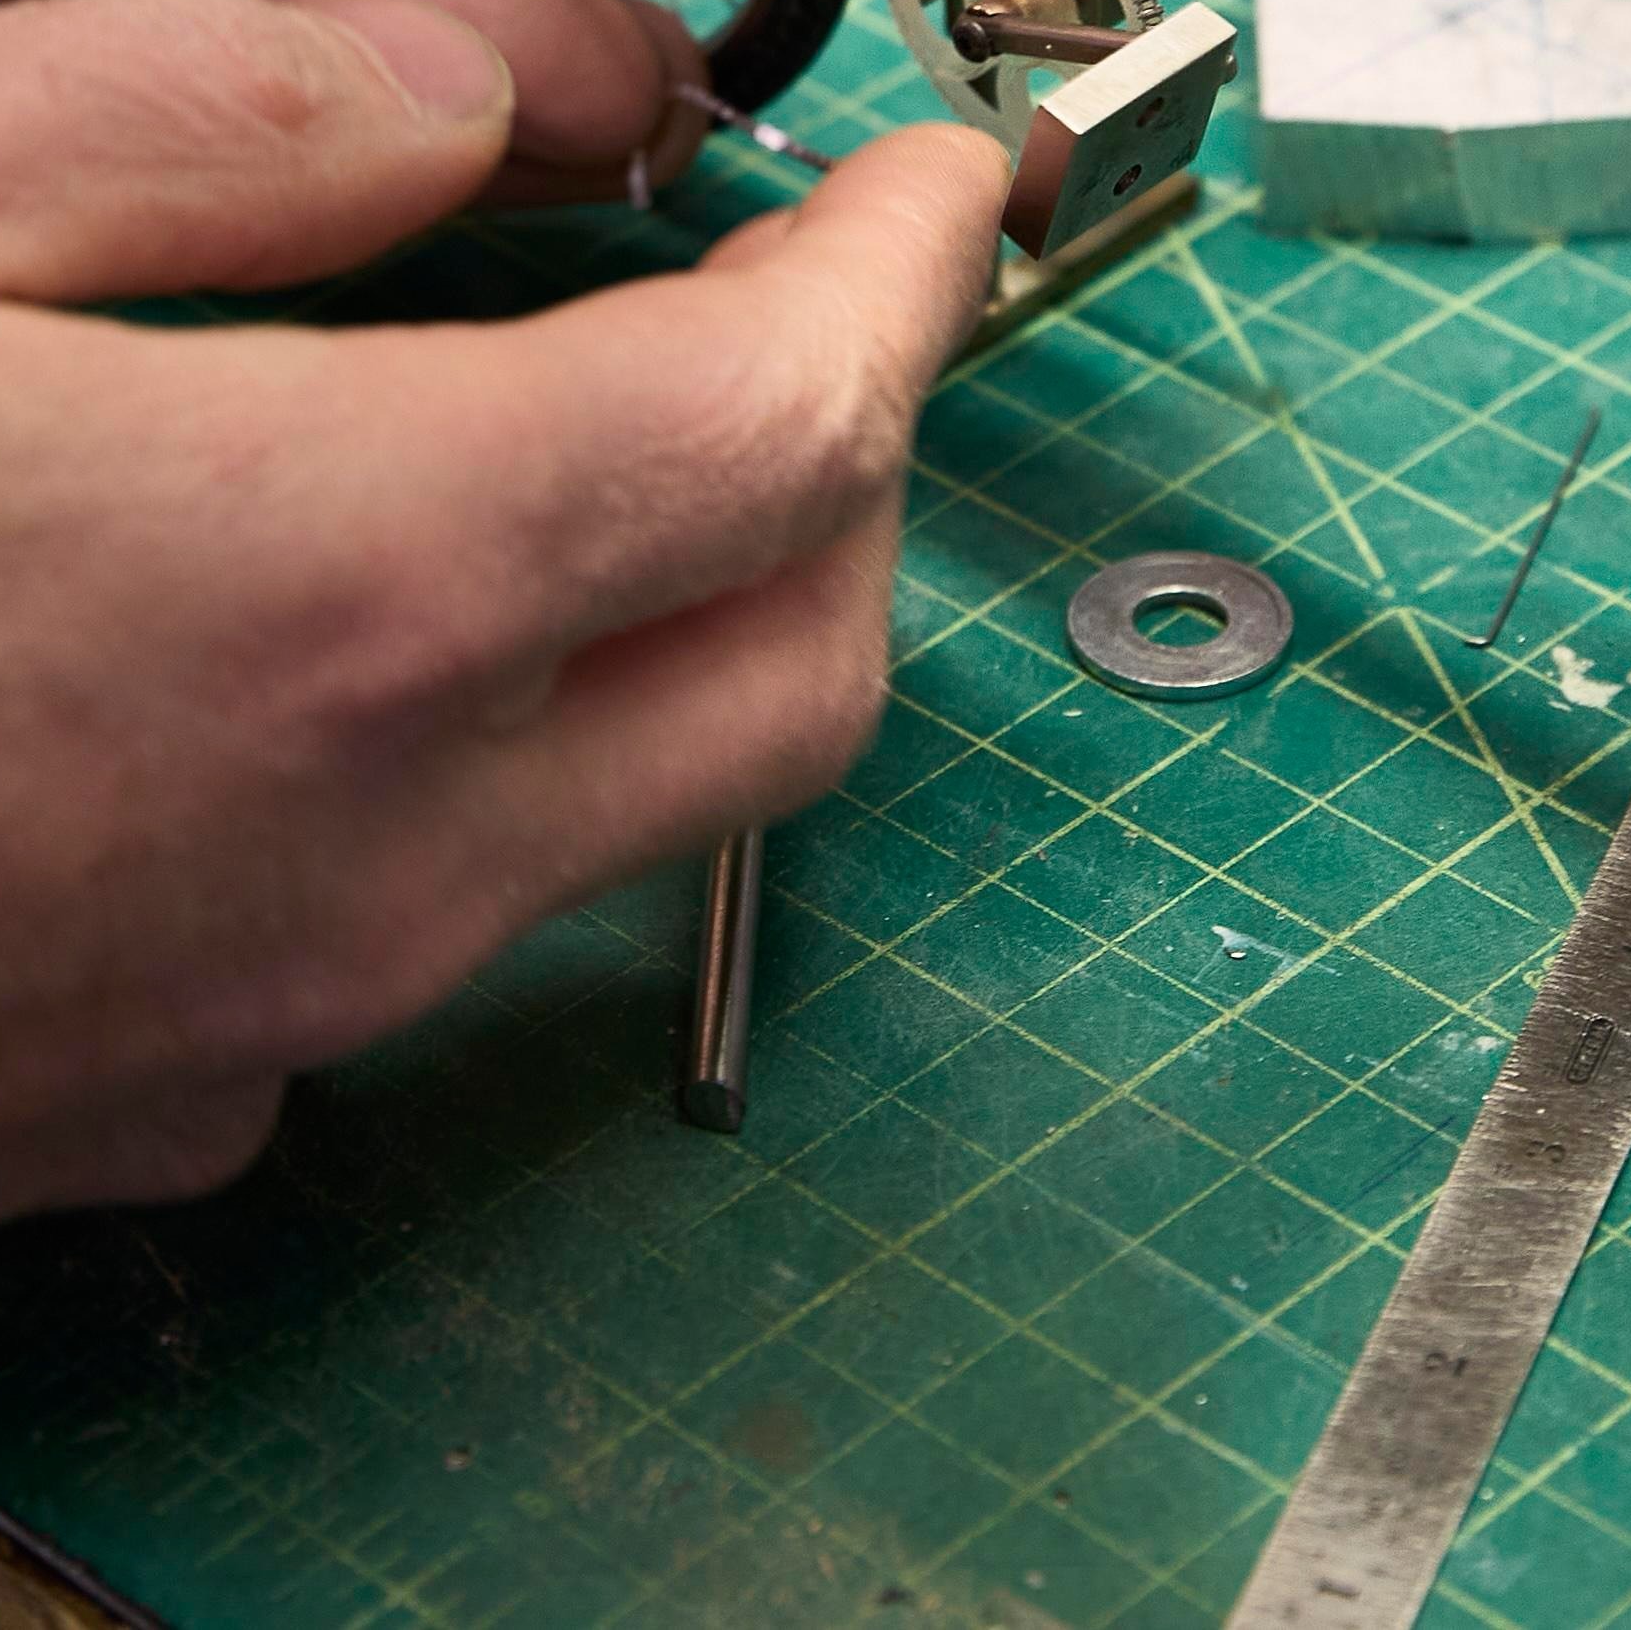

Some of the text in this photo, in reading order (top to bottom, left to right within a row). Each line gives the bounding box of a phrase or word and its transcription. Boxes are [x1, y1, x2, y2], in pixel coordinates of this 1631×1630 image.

[1525, 1140, 1566, 1163] 3
[1425, 1352, 1468, 1378] 2
[1316, 1576, 1360, 1599] 1
